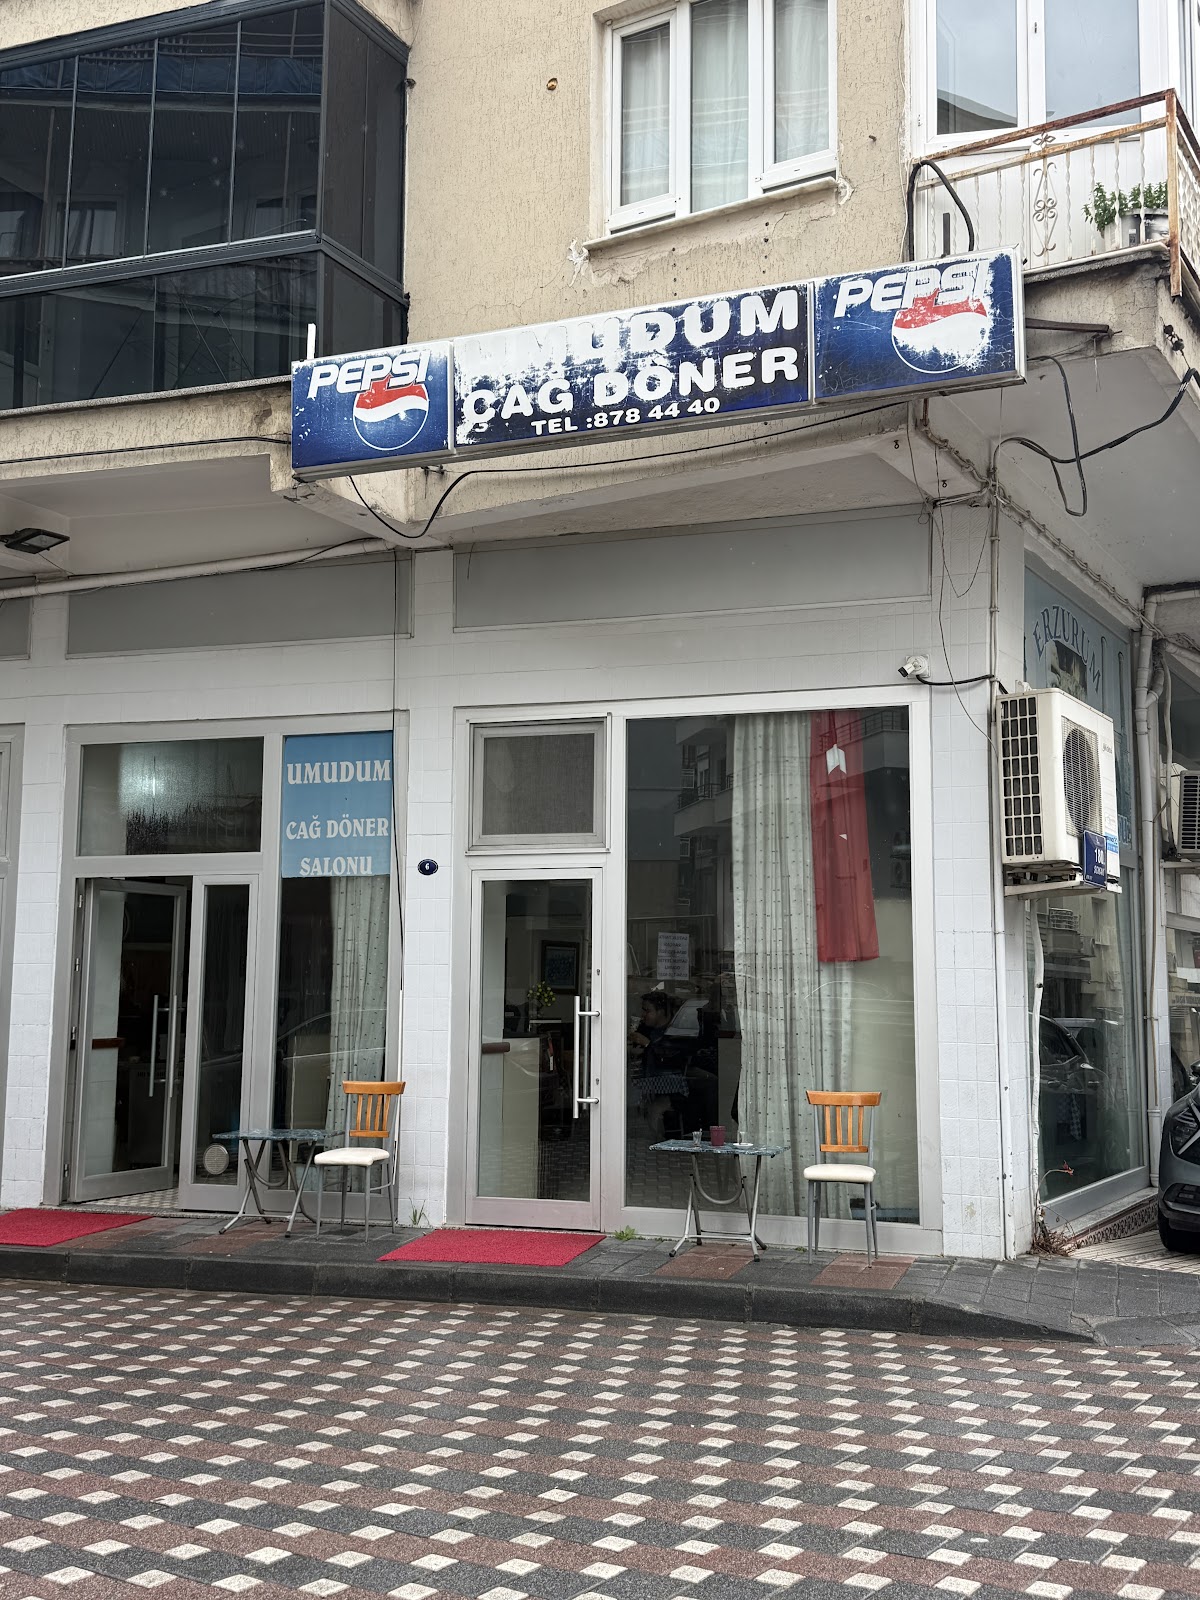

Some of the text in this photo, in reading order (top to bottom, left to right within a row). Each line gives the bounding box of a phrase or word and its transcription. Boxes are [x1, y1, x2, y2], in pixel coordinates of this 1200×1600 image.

[834, 260, 990, 318] PEPSI
[307, 350, 431, 400] PEPSI
[531, 397, 721, 436] TEL :878 44 40
[1033, 604, 1102, 694] ERZURUM
[286, 759, 391, 785] UMUDUM
[285, 813, 389, 840] CAĞ DÖNER
[299, 856, 373, 876] SALONU
[424, 862, 430, 871] 6
